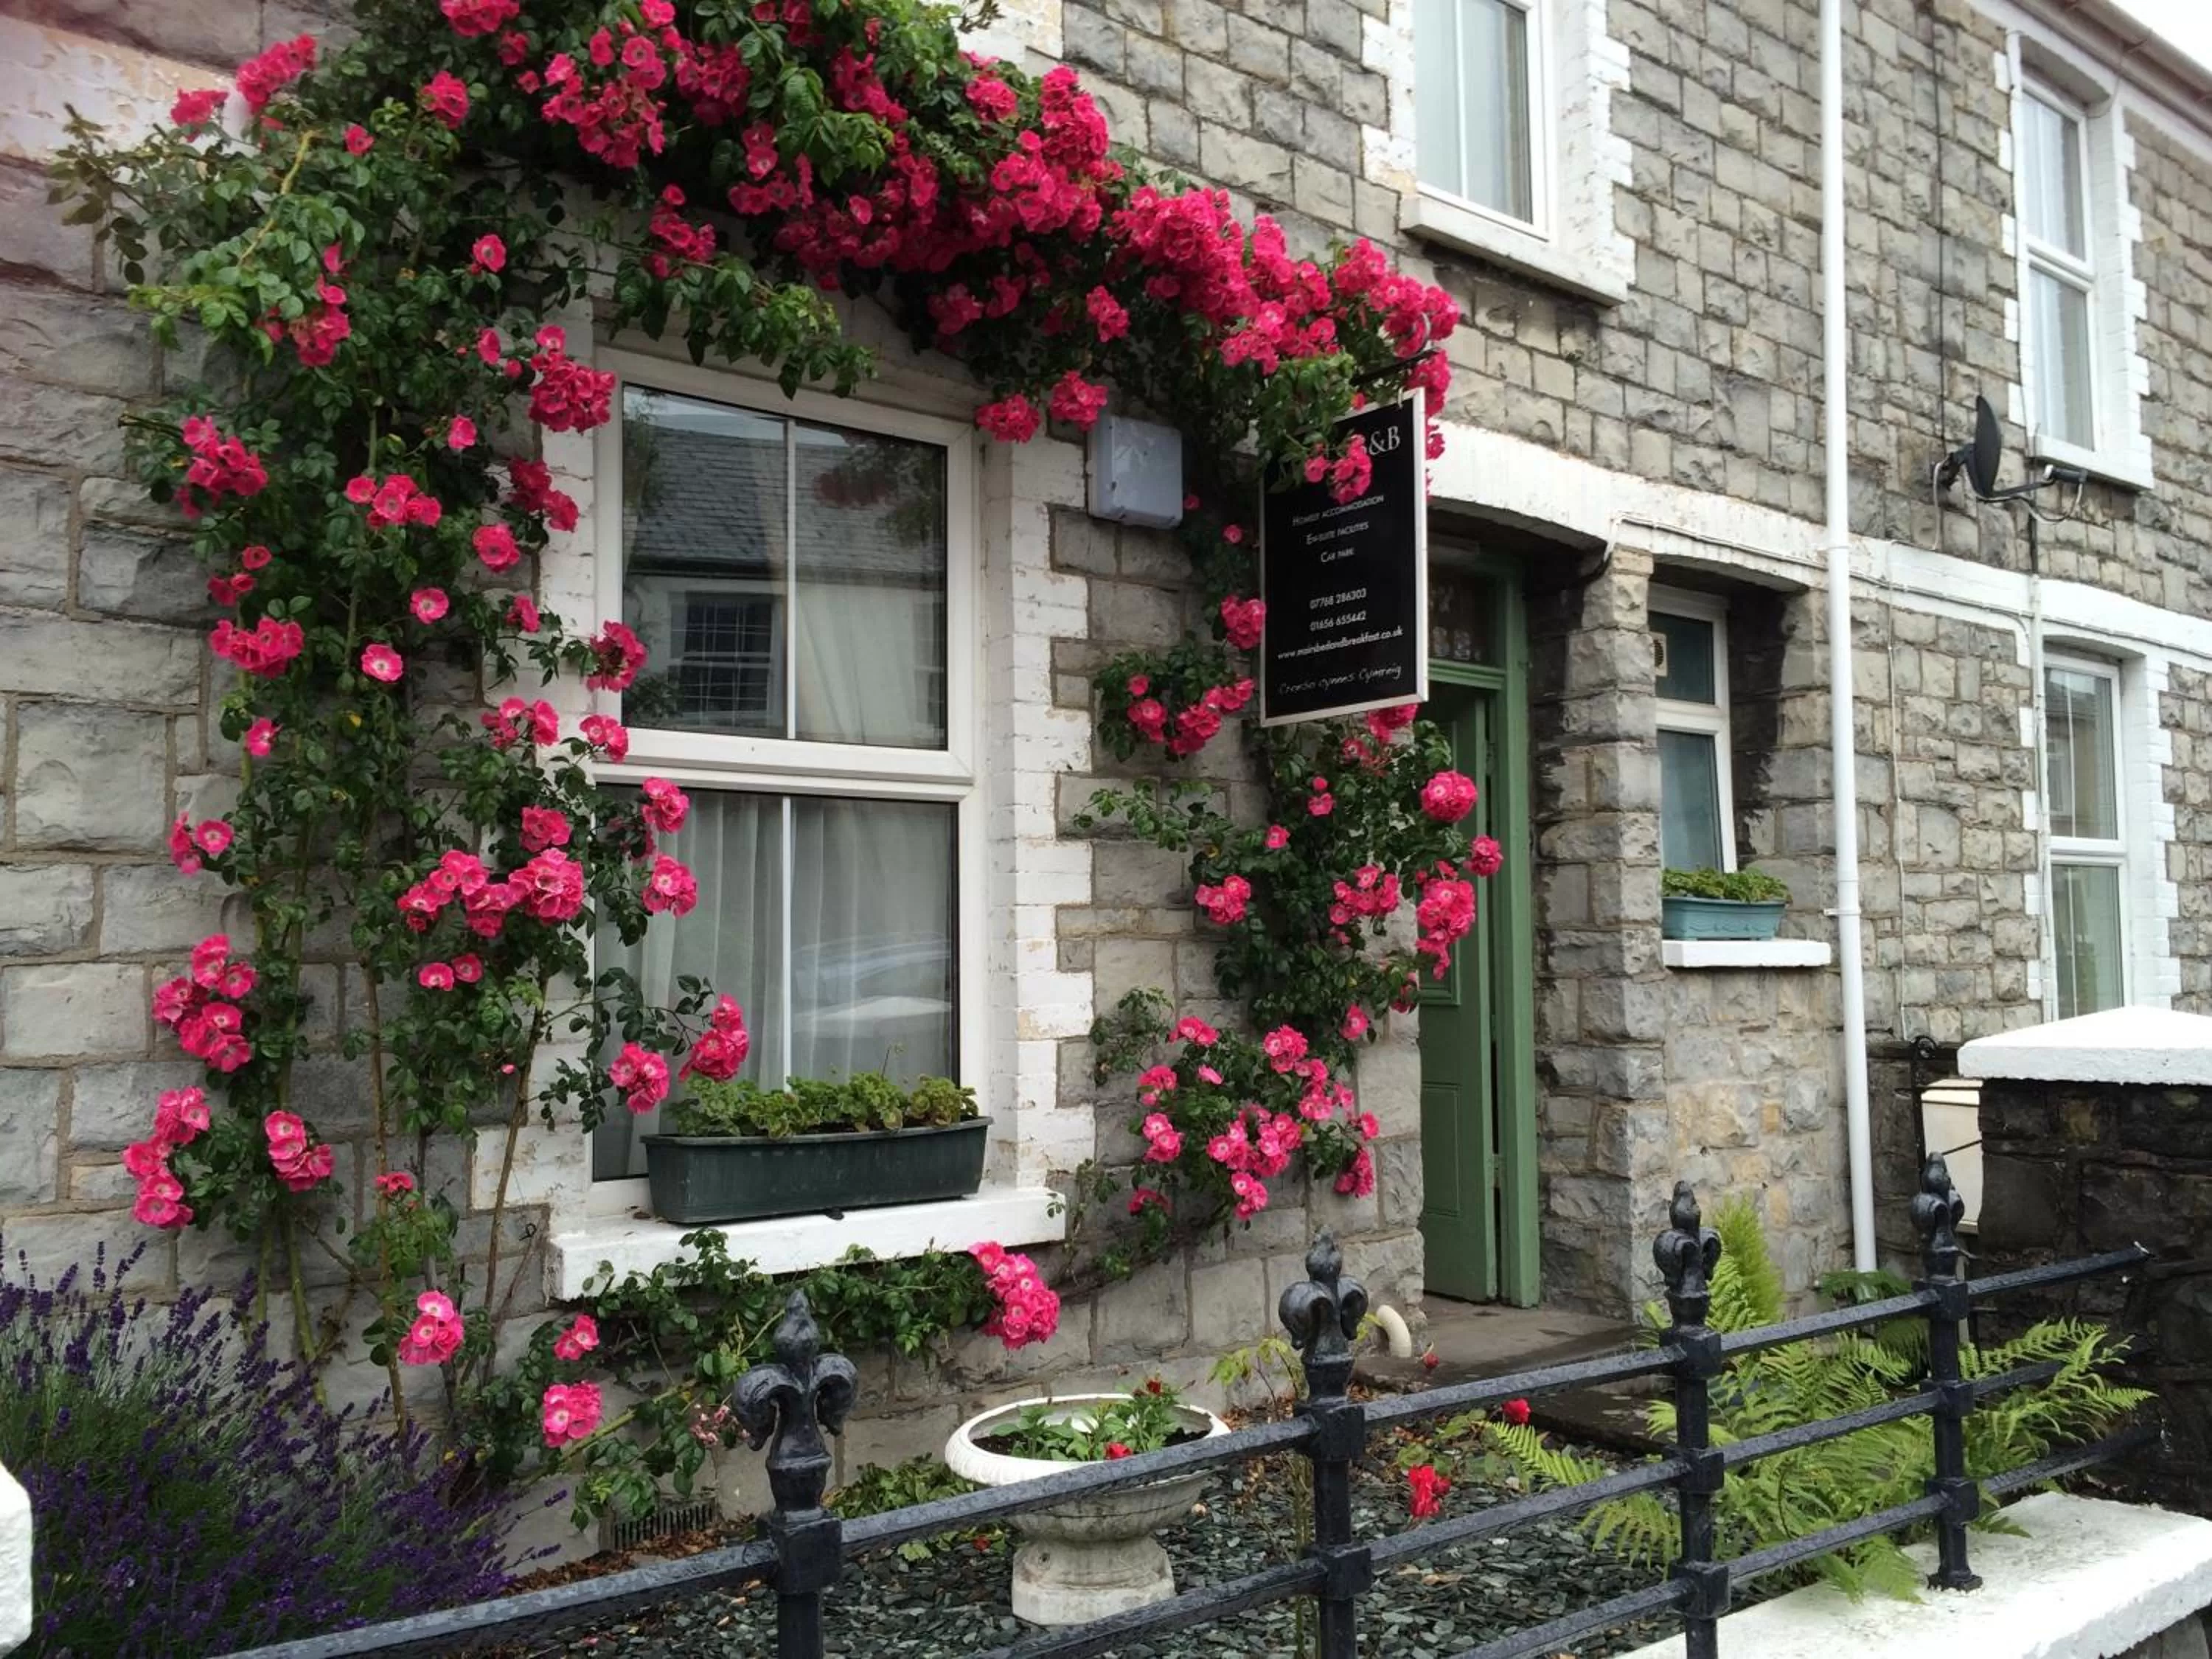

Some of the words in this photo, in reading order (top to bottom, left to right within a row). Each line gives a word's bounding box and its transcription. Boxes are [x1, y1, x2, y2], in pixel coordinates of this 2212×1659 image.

[1321, 495, 1384, 518] ACCOMMODATION
[1337, 521, 1369, 537] FACILITIES
[1310, 618, 1334, 632] 01656
